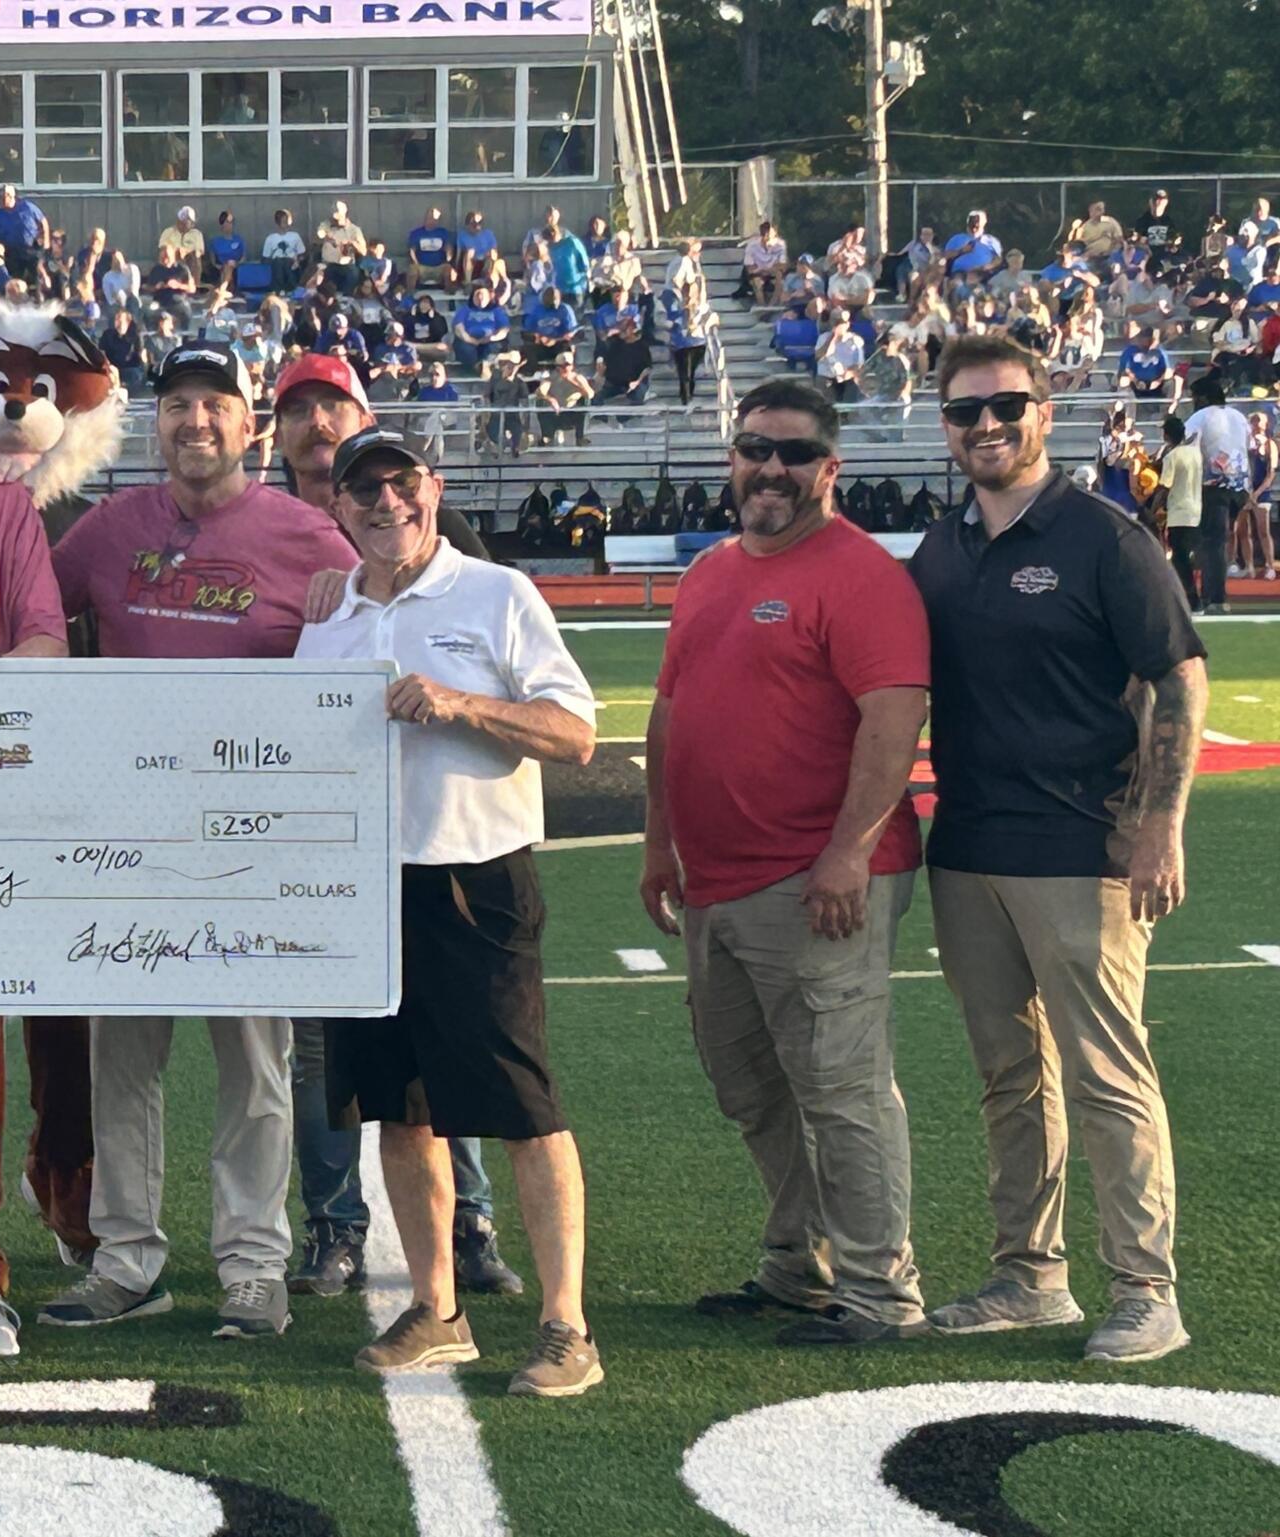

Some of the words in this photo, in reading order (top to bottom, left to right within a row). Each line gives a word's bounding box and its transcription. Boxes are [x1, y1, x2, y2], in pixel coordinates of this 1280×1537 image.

[21, 4, 333, 29] HORIZON
[361, 0, 564, 22] BANK
[213, 737, 292, 770] 9/11/26
[279, 883, 357, 898] DOLLARS
